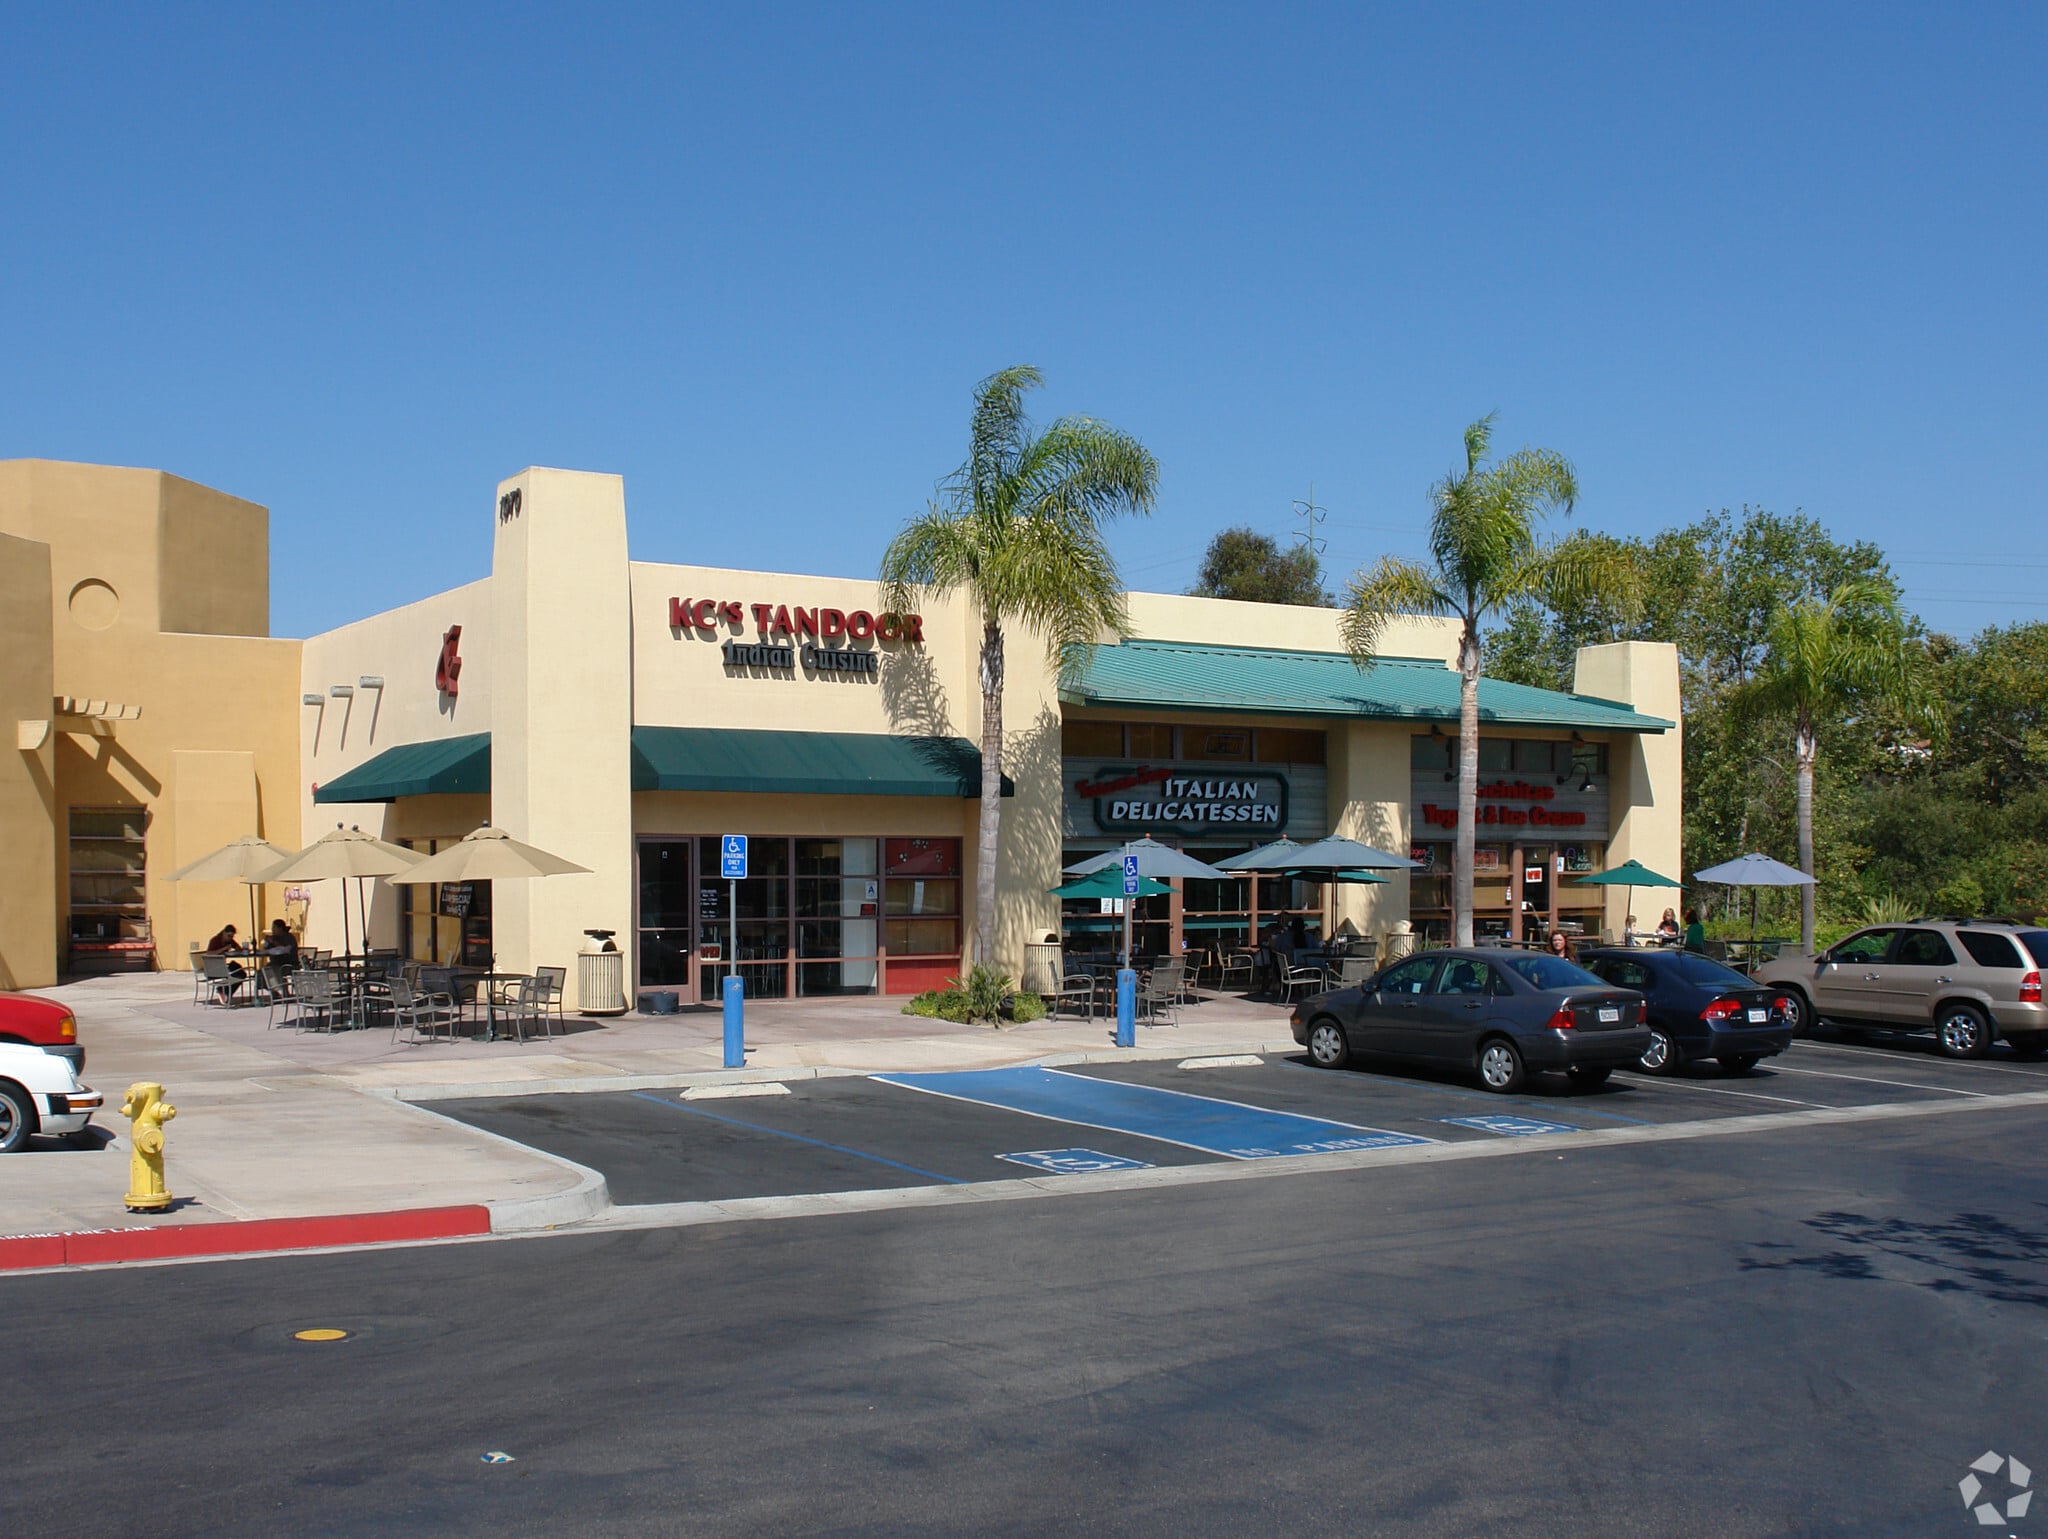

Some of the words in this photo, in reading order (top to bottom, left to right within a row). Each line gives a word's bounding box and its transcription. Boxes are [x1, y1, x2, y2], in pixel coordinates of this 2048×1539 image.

[669, 597, 744, 629] KC'S
[750, 603, 925, 642] TANDOOR
[722, 639, 794, 668] Indian
[801, 642, 878, 672] Cuisine
[1163, 778, 1258, 799] ITALIAN
[1111, 801, 1280, 823] DELICATESSEN
[1483, 805, 1498, 824] &
